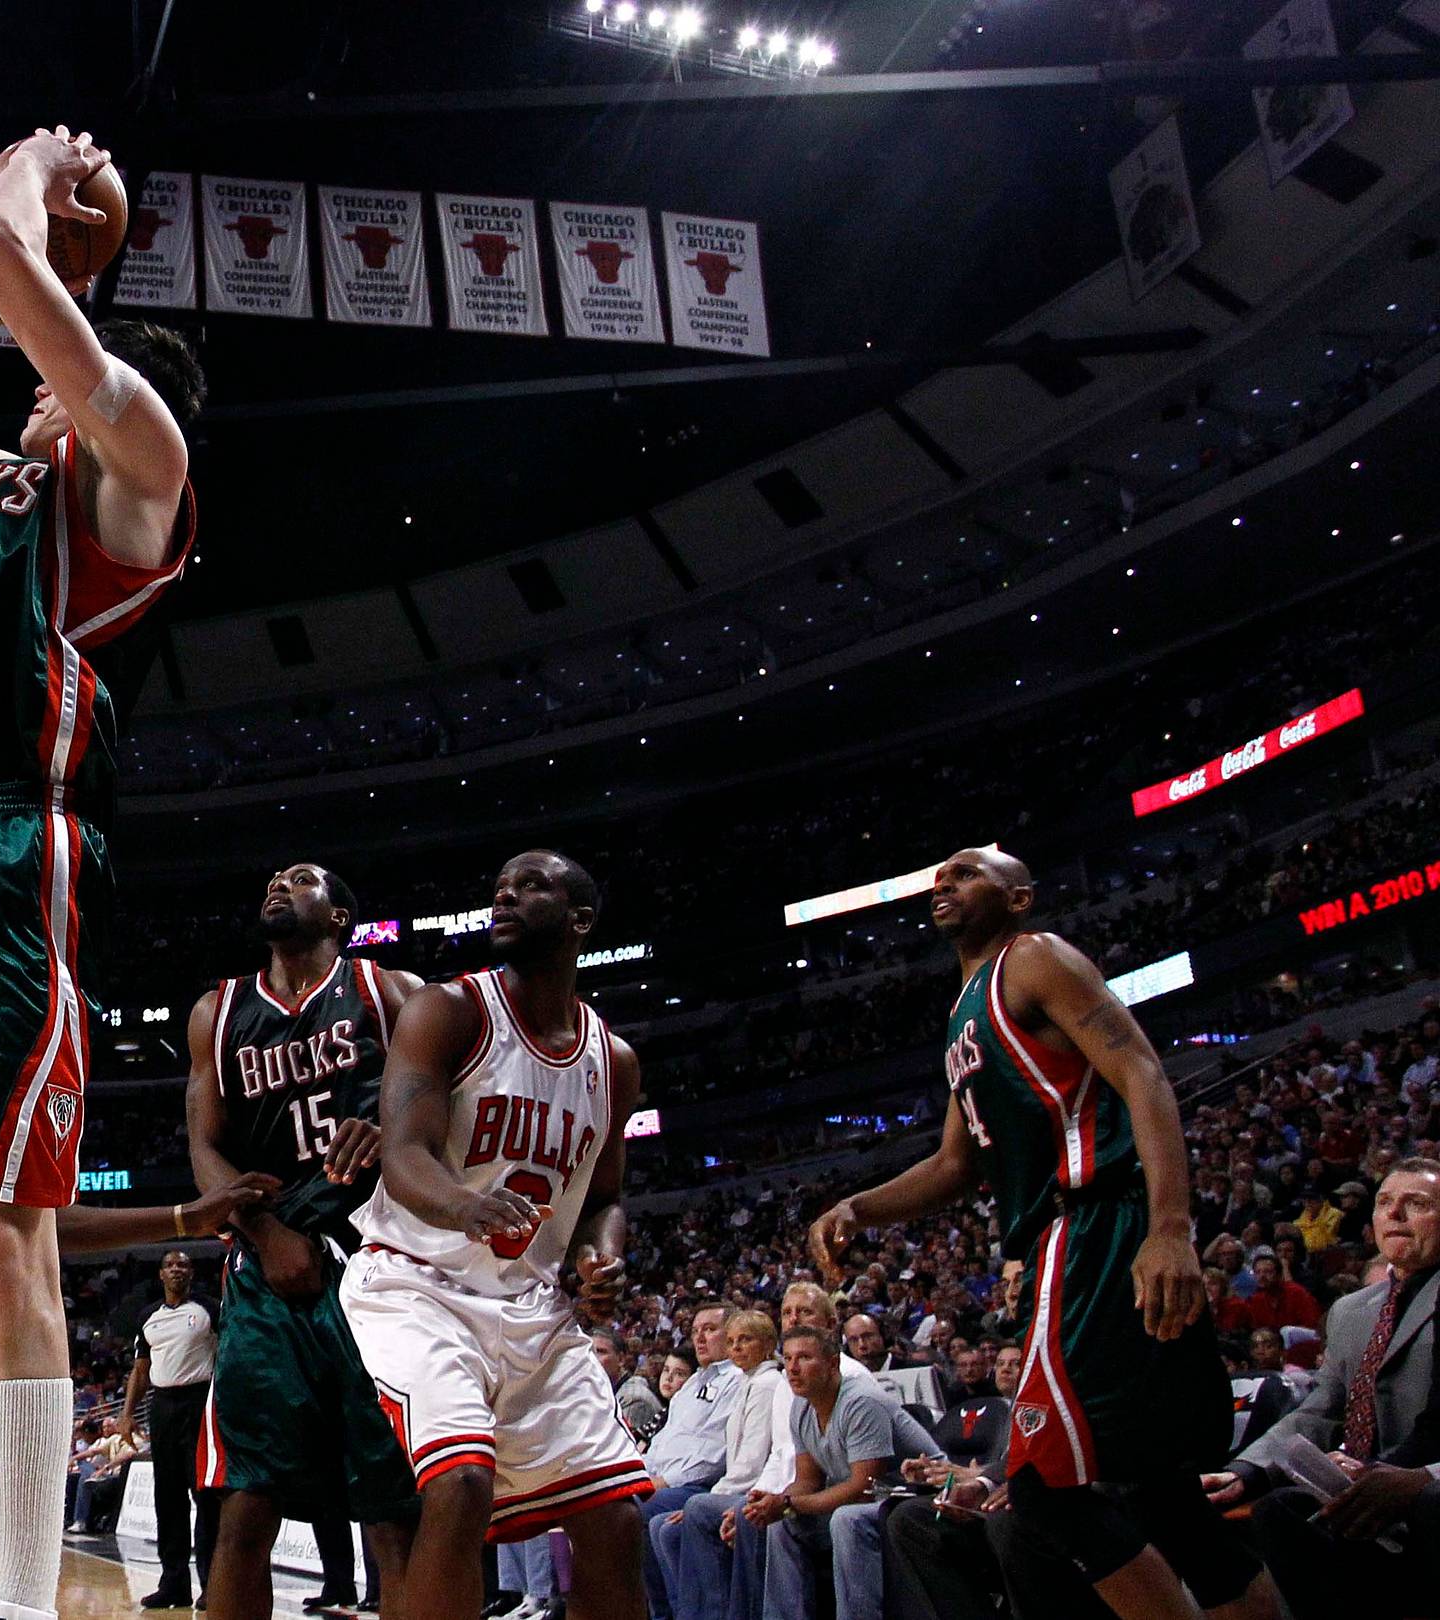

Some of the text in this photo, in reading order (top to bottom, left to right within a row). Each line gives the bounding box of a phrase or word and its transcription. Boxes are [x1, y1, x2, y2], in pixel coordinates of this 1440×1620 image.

[215, 184, 291, 201] CHICAGO
[226, 199, 282, 215] BULLS
[332, 194, 408, 211] CHICAGO
[347, 210, 399, 225] BULLS
[449, 203, 523, 219] CHICAGO
[463, 218, 514, 232] BULLS
[563, 210, 636, 228] CHICAGO
[577, 225, 628, 240] BULLS
[675, 221, 747, 241] CHICAGO
[687, 236, 728, 253] BULLS
[234, 259, 280, 271] EASTERN
[224, 271, 291, 284] CONFERENCE
[472, 275, 515, 287] EASTERN
[225, 283, 291, 297] CHAMPIONS
[464, 288, 527, 301] CONFERENCE
[588, 285, 632, 297] EASTERN
[465, 301, 528, 313] CHAMPIONS
[580, 298, 643, 311] CONFERENCE
[696, 296, 739, 309] EASTERN
[583, 309, 645, 322] CHAMPIONS
[688, 307, 749, 322] CONFERENCE
[690, 319, 750, 336] CHAMPIONS
[1298, 897, 1347, 936] WIN
[1350, 892, 1371, 920] A
[1371, 869, 1425, 911] 2010
[235, 1018, 361, 1100] BUCKS
[288, 1089, 339, 1163] 15
